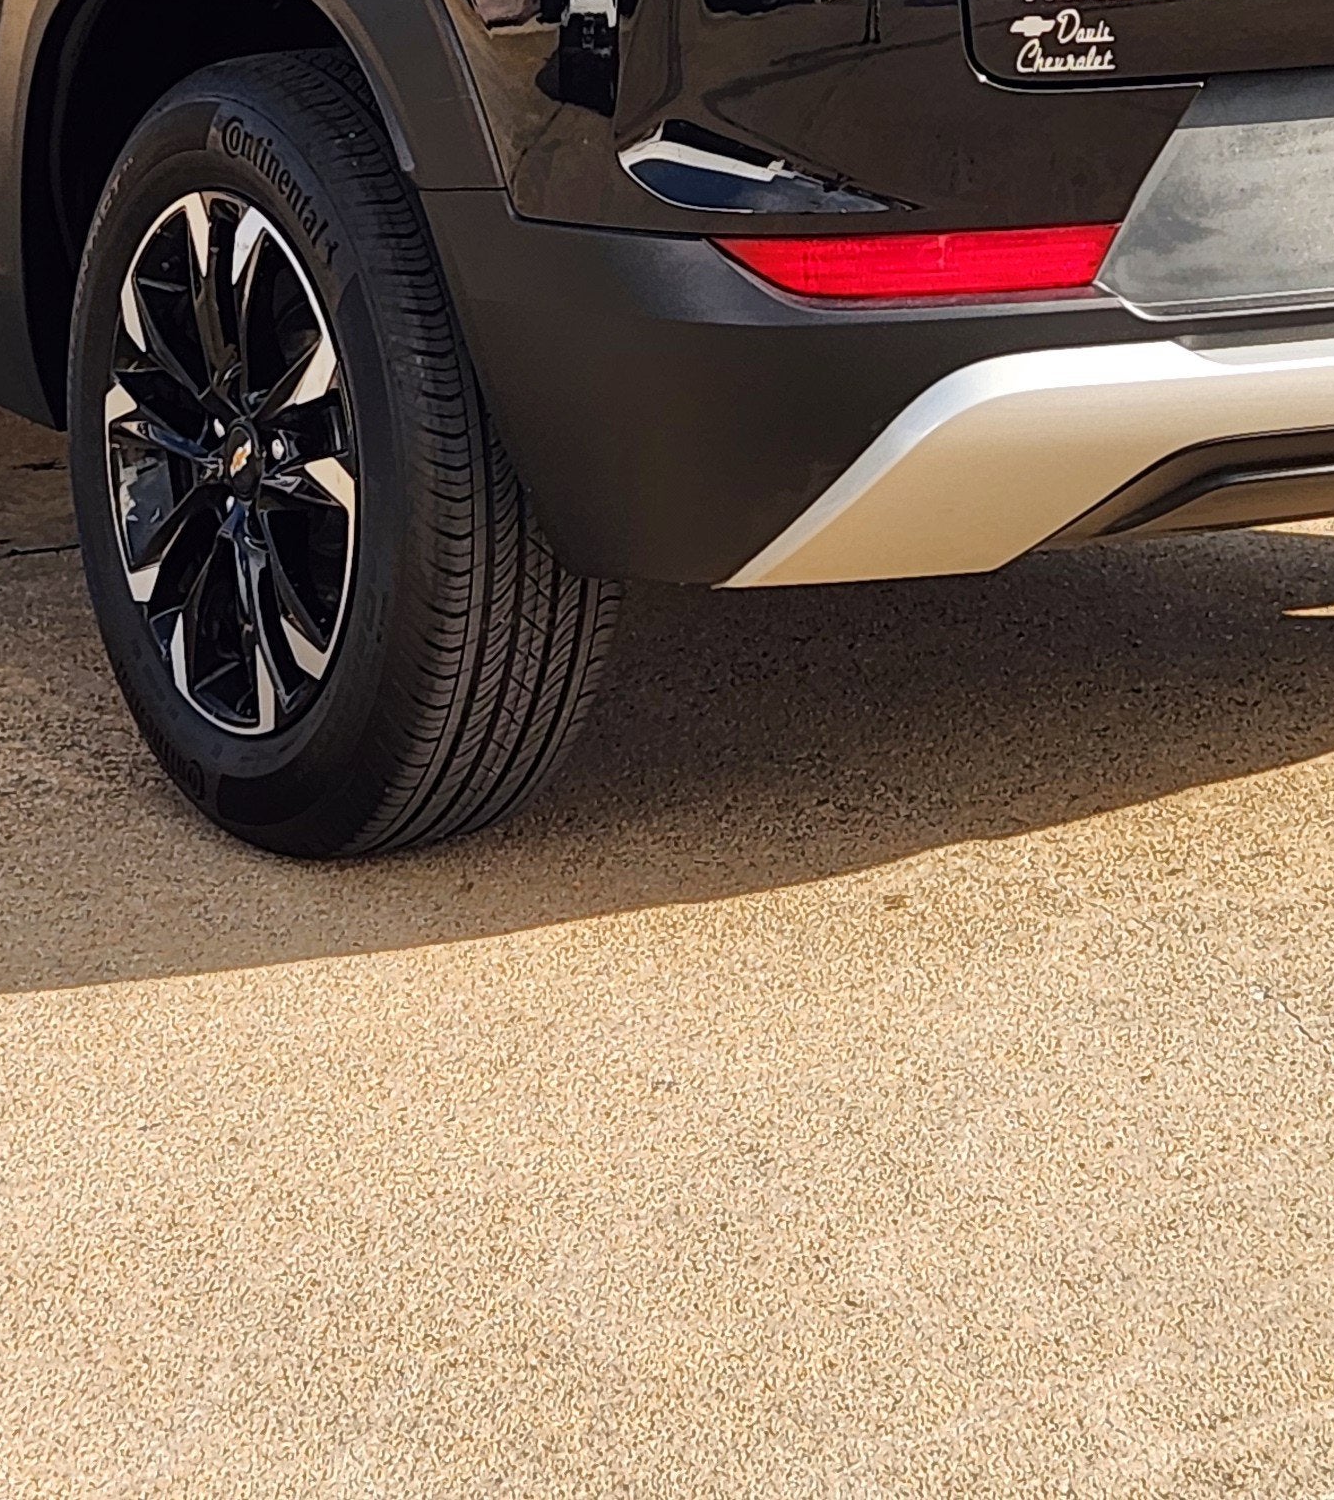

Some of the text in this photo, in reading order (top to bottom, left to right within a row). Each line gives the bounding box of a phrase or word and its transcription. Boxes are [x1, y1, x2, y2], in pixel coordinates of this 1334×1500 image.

[1056, 7, 1115, 44] Davis
[1016, 38, 1116, 74] Chevrolet
[221, 115, 329, 247] Continental
